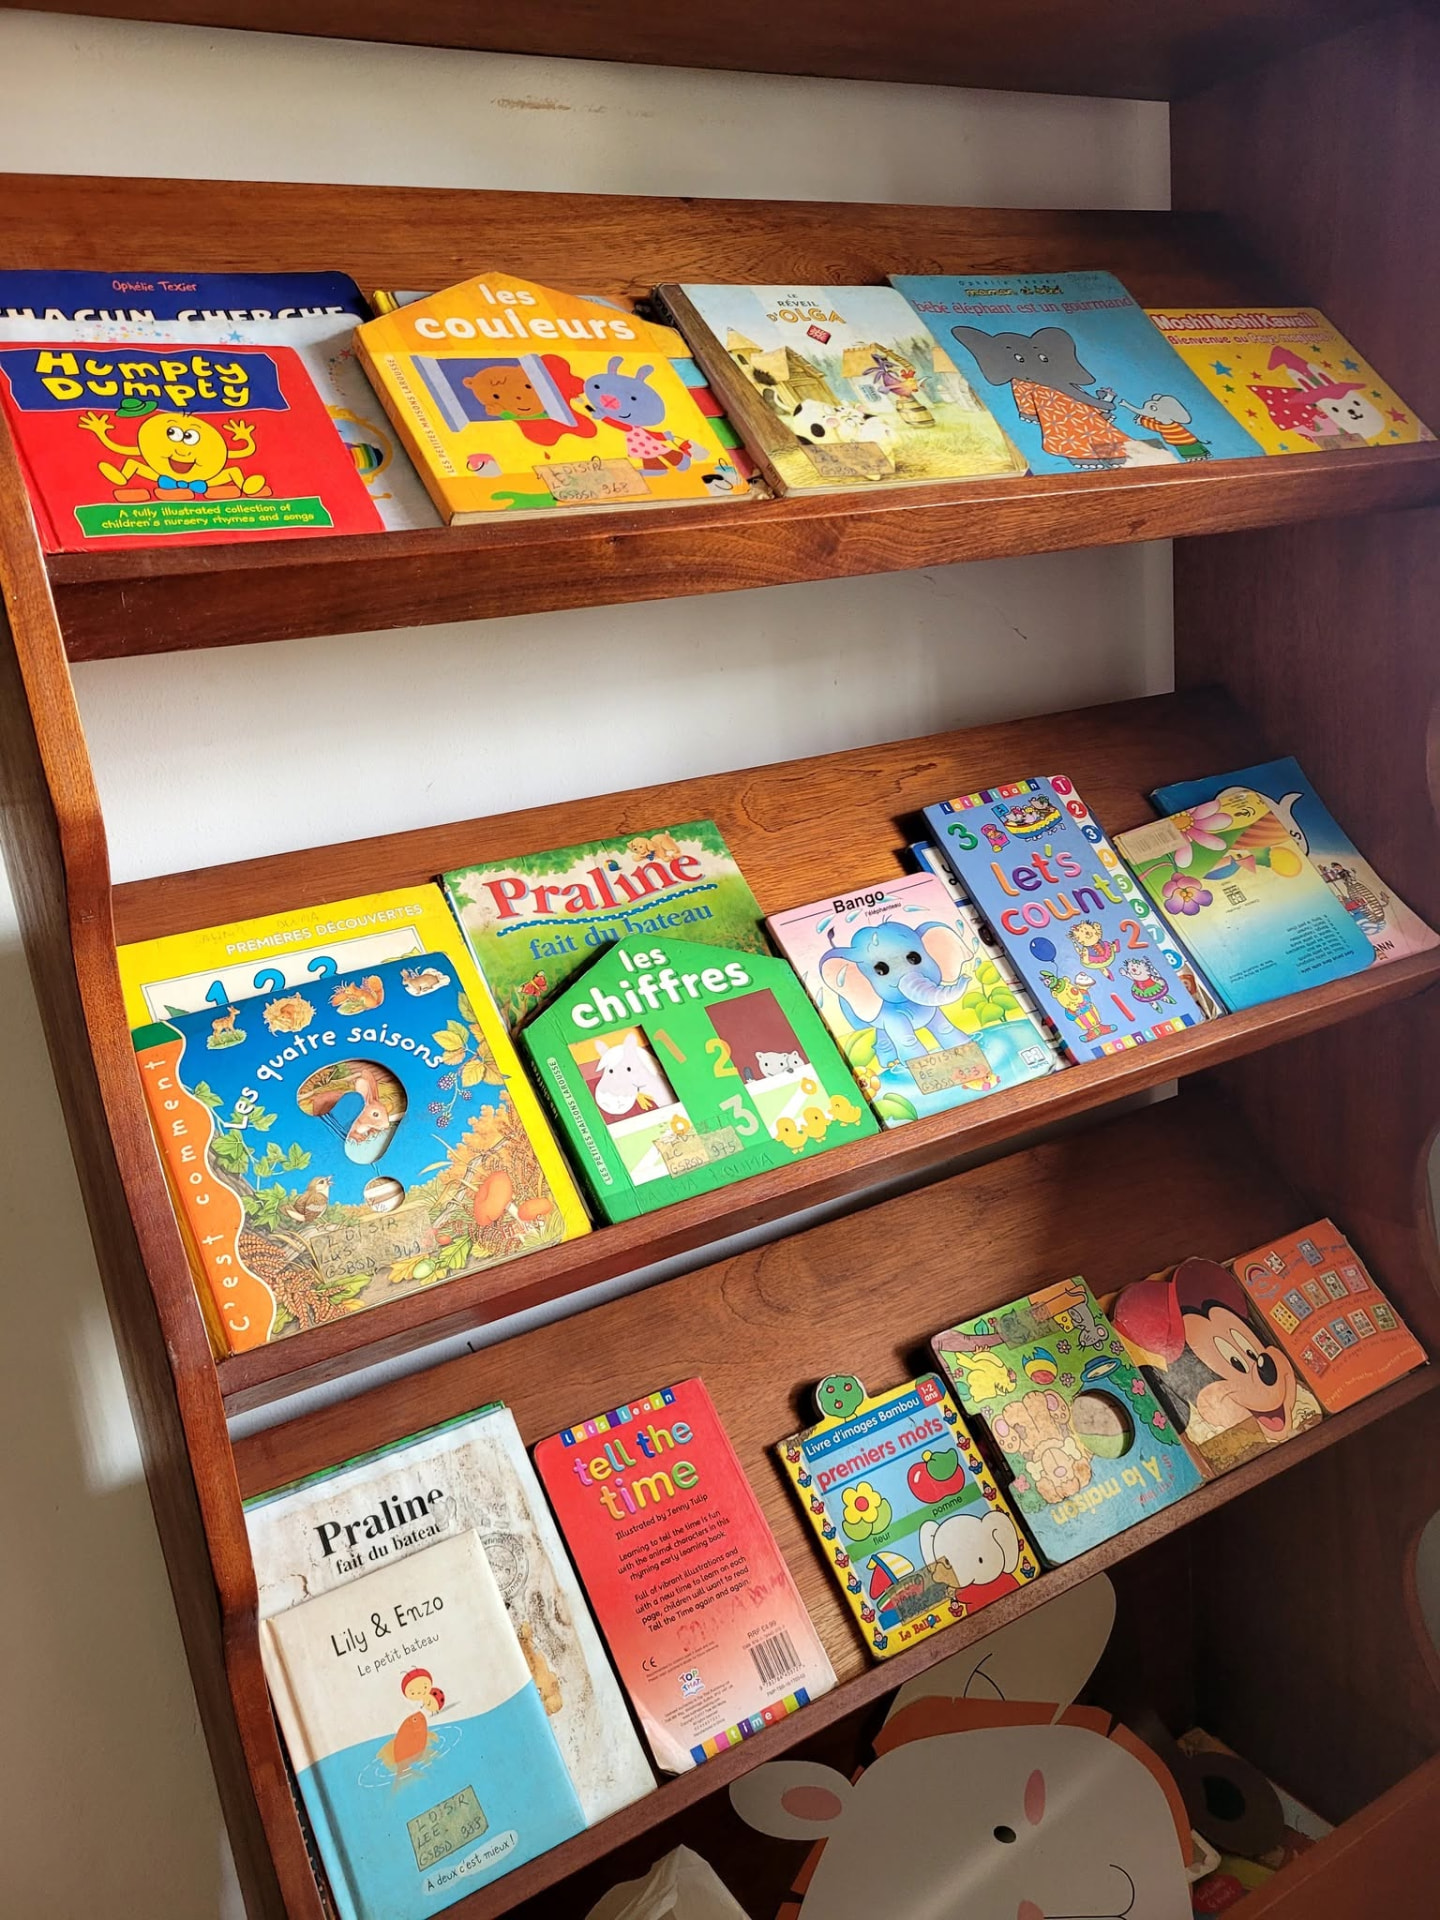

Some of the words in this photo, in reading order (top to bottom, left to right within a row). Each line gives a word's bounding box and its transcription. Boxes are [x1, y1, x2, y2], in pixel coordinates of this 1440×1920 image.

[112, 280, 155, 293] Ophélie
[157, 281, 198, 292] Texier
[478, 283, 536, 306] les
[777, 299, 820, 308] RÉVEIL
[912, 300, 951, 314] bébé
[952, 301, 1015, 317] éléphant
[1016, 302, 1040, 313] est
[1041, 302, 1059, 312] un
[1062, 296, 1135, 315] gourmand
[414, 308, 636, 340] couleurs
[1151, 314, 1206, 331] Moshi
[1205, 314, 1260, 331] Moshi
[1167, 335, 1231, 345] Bienvenue
[1233, 335, 1248, 343] au
[35, 351, 249, 384] Humpty
[41, 377, 250, 407] Dumpty
[101, 518, 161, 529] children's
[164, 516, 208, 527] nursery
[212, 514, 256, 524] rhymes
[258, 512, 280, 521] and
[283, 512, 315, 522] songs
[118, 508, 129, 519] A
[132, 508, 157, 518] fully
[161, 506, 220, 517] illustrated
[225, 504, 277, 514] collection
[280, 503, 292, 512] of
[1071, 802, 1084, 816] 2
[947, 822, 979, 850] 3
[1086, 828, 1099, 842] 3
[990, 844, 1082, 897] let's
[1103, 850, 1115, 864] 4
[482, 854, 704, 920] Praline
[1118, 876, 1130, 892] 5
[832, 891, 885, 914] Bango
[1001, 873, 1123, 936] count
[1134, 900, 1147, 915] 6
[226, 927, 312, 956] PREMIÈRES
[315, 904, 424, 937] DÉCOUVERTES
[529, 934, 580, 960] fait
[584, 924, 619, 947] du
[622, 904, 715, 936] bateau
[1119, 919, 1150, 950] 2
[617, 947, 668, 973] les
[1165, 952, 1179, 967] 8
[571, 961, 751, 1030] chiffres
[1110, 992, 1136, 1022] 1
[1106, 1021, 1184, 1053] counting
[653, 1029, 687, 1063] 1
[705, 1038, 738, 1078] 2
[223, 1086, 259, 1130] Les
[256, 1030, 338, 1083] quatre
[346, 1023, 446, 1070] saisons
[549, 1060, 573, 1098] LAROUSSE
[567, 1100, 589, 1135] MAISONS
[719, 1094, 760, 1136] 3
[144, 1058, 210, 1206] comment
[585, 1136, 604, 1167] PETITES
[599, 1166, 612, 1183] LES
[202, 1234, 251, 1332] C'est
[921, 1383, 934, 1394] 1-2
[924, 1391, 939, 1402] ans
[620, 1393, 673, 1419] learn
[806, 1439, 832, 1456] Livre
[832, 1416, 879, 1444] d'images
[878, 1397, 920, 1422] Bambou
[573, 1439, 637, 1486] tell
[636, 1421, 694, 1458] the
[817, 1440, 897, 1492] premiers
[897, 1417, 944, 1450] mots
[600, 1460, 699, 1521] time
[1120, 1466, 1148, 1487] la
[931, 1495, 963, 1517] pomme
[1050, 1476, 1122, 1526] maison
[312, 1487, 445, 1558] Praline
[615, 1515, 656, 1540] Illustrated
[655, 1511, 668, 1523] by
[667, 1503, 691, 1517] Jenny
[690, 1494, 708, 1507] Tulip
[617, 1561, 635, 1575] with
[635, 1555, 648, 1567] the
[648, 1545, 673, 1561] animal
[673, 1527, 709, 1548] characters
[716, 1516, 730, 1528] this
[618, 1542, 650, 1562] Learning
[650, 1538, 659, 1548] to
[659, 1532, 672, 1544] tell
[672, 1526, 685, 1538] the
[684, 1519, 702, 1531] time
[708, 1510, 722, 1521] fun
[873, 1531, 892, 1546] fleur
[335, 1555, 364, 1575] fait
[367, 1545, 390, 1562] du
[630, 1563, 660, 1582] rhyming
[660, 1552, 680, 1567] early
[679, 1541, 709, 1558] learning
[708, 1531, 726, 1543] book
[634, 1590, 649, 1602] Full
[649, 1586, 659, 1596] of
[658, 1573, 684, 1590] vibrant
[683, 1554, 726, 1578] illustrations
[725, 1546, 739, 1559] and
[635, 1602, 653, 1615] with
[659, 1591, 675, 1603] new
[675, 1582, 693, 1596] time
[692, 1578, 701, 1587] to
[700, 1568, 720, 1583] learn
[719, 1564, 730, 1574] on
[729, 1555, 747, 1568] each
[641, 1611, 664, 1627] page,
[663, 1595, 693, 1613] children
[691, 1587, 706, 1599] will
[705, 1578, 725, 1592] want
[724, 1573, 733, 1582] to
[732, 1566, 750, 1579] read
[647, 1622, 663, 1634] Tell
[663, 1614, 677, 1626] the
[676, 1605, 695, 1619] Time
[694, 1596, 716, 1611] again
[715, 1588, 730, 1600] and
[729, 1579, 750, 1593] again
[370, 1612, 392, 1638] &
[394, 1596, 444, 1628] Enzo
[898, 1630, 912, 1642] Le
[357, 1664, 372, 1678] Le
[374, 1649, 402, 1672] petit
[402, 1633, 440, 1656] bateau
[678, 1668, 698, 1683] TOP
[681, 1678, 702, 1692] THAT
[730, 1711, 774, 1739] time
[437, 1868, 458, 1886] deux
[459, 1853, 482, 1874] c'est
[483, 1842, 510, 1860] mieux
